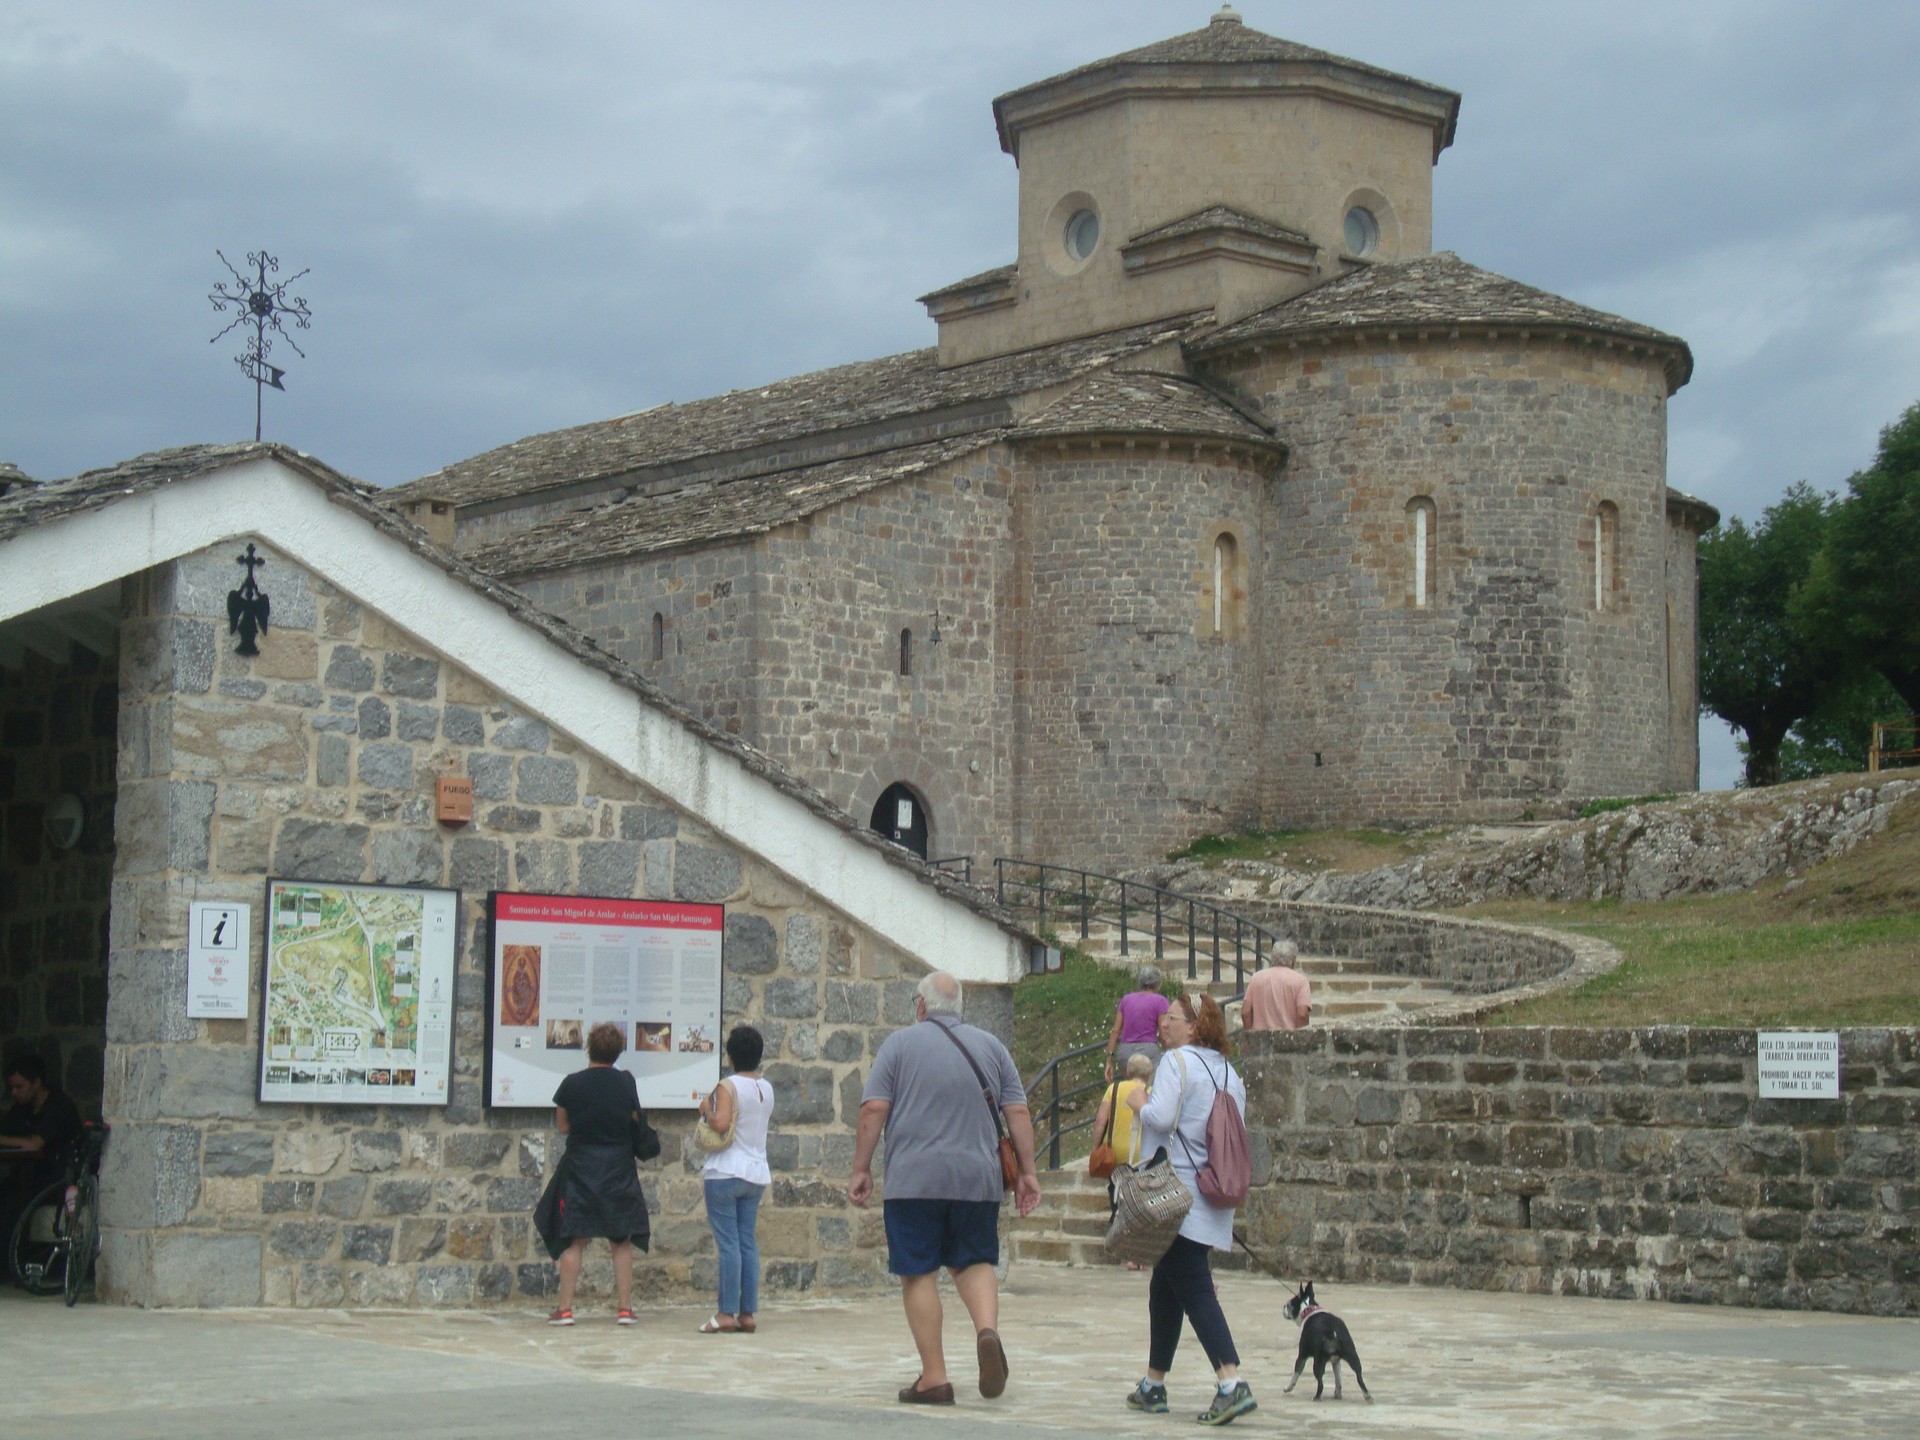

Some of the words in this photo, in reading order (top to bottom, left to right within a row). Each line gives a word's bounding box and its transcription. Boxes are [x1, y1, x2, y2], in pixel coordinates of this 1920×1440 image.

[443, 785, 470, 794] FUEGO
[509, 905, 541, 915] Santuario
[541, 906, 550, 915] de
[551, 907, 563, 916] San
[564, 908, 586, 919] Miguel
[587, 909, 595, 918] de
[596, 909, 616, 919] Aralar
[621, 911, 649, 920] Aralarko
[650, 912, 661, 921] San
[662, 913, 680, 923] Migel
[681, 914, 712, 925] Santutegia
[1775, 1041, 1784, 1050] ETA
[1787, 1041, 1813, 1050] SOLARIUM
[1816, 1041, 1837, 1050] BEZELA
[1765, 1052, 1794, 1061] ERABILTZEA
[1796, 1052, 1830, 1061] DEBEKATUTA
[1760, 1070, 1789, 1079] PROHIBIDO
[1792, 1070, 1812, 1079] HACER
[1815, 1071, 1836, 1079] PICNIC
[1772, 1081, 1776, 1089] Y
[1778, 1081, 1798, 1089] TOMAR
[1801, 1081, 1808, 1090] EL
[1811, 1082, 1823, 1090] SOL
